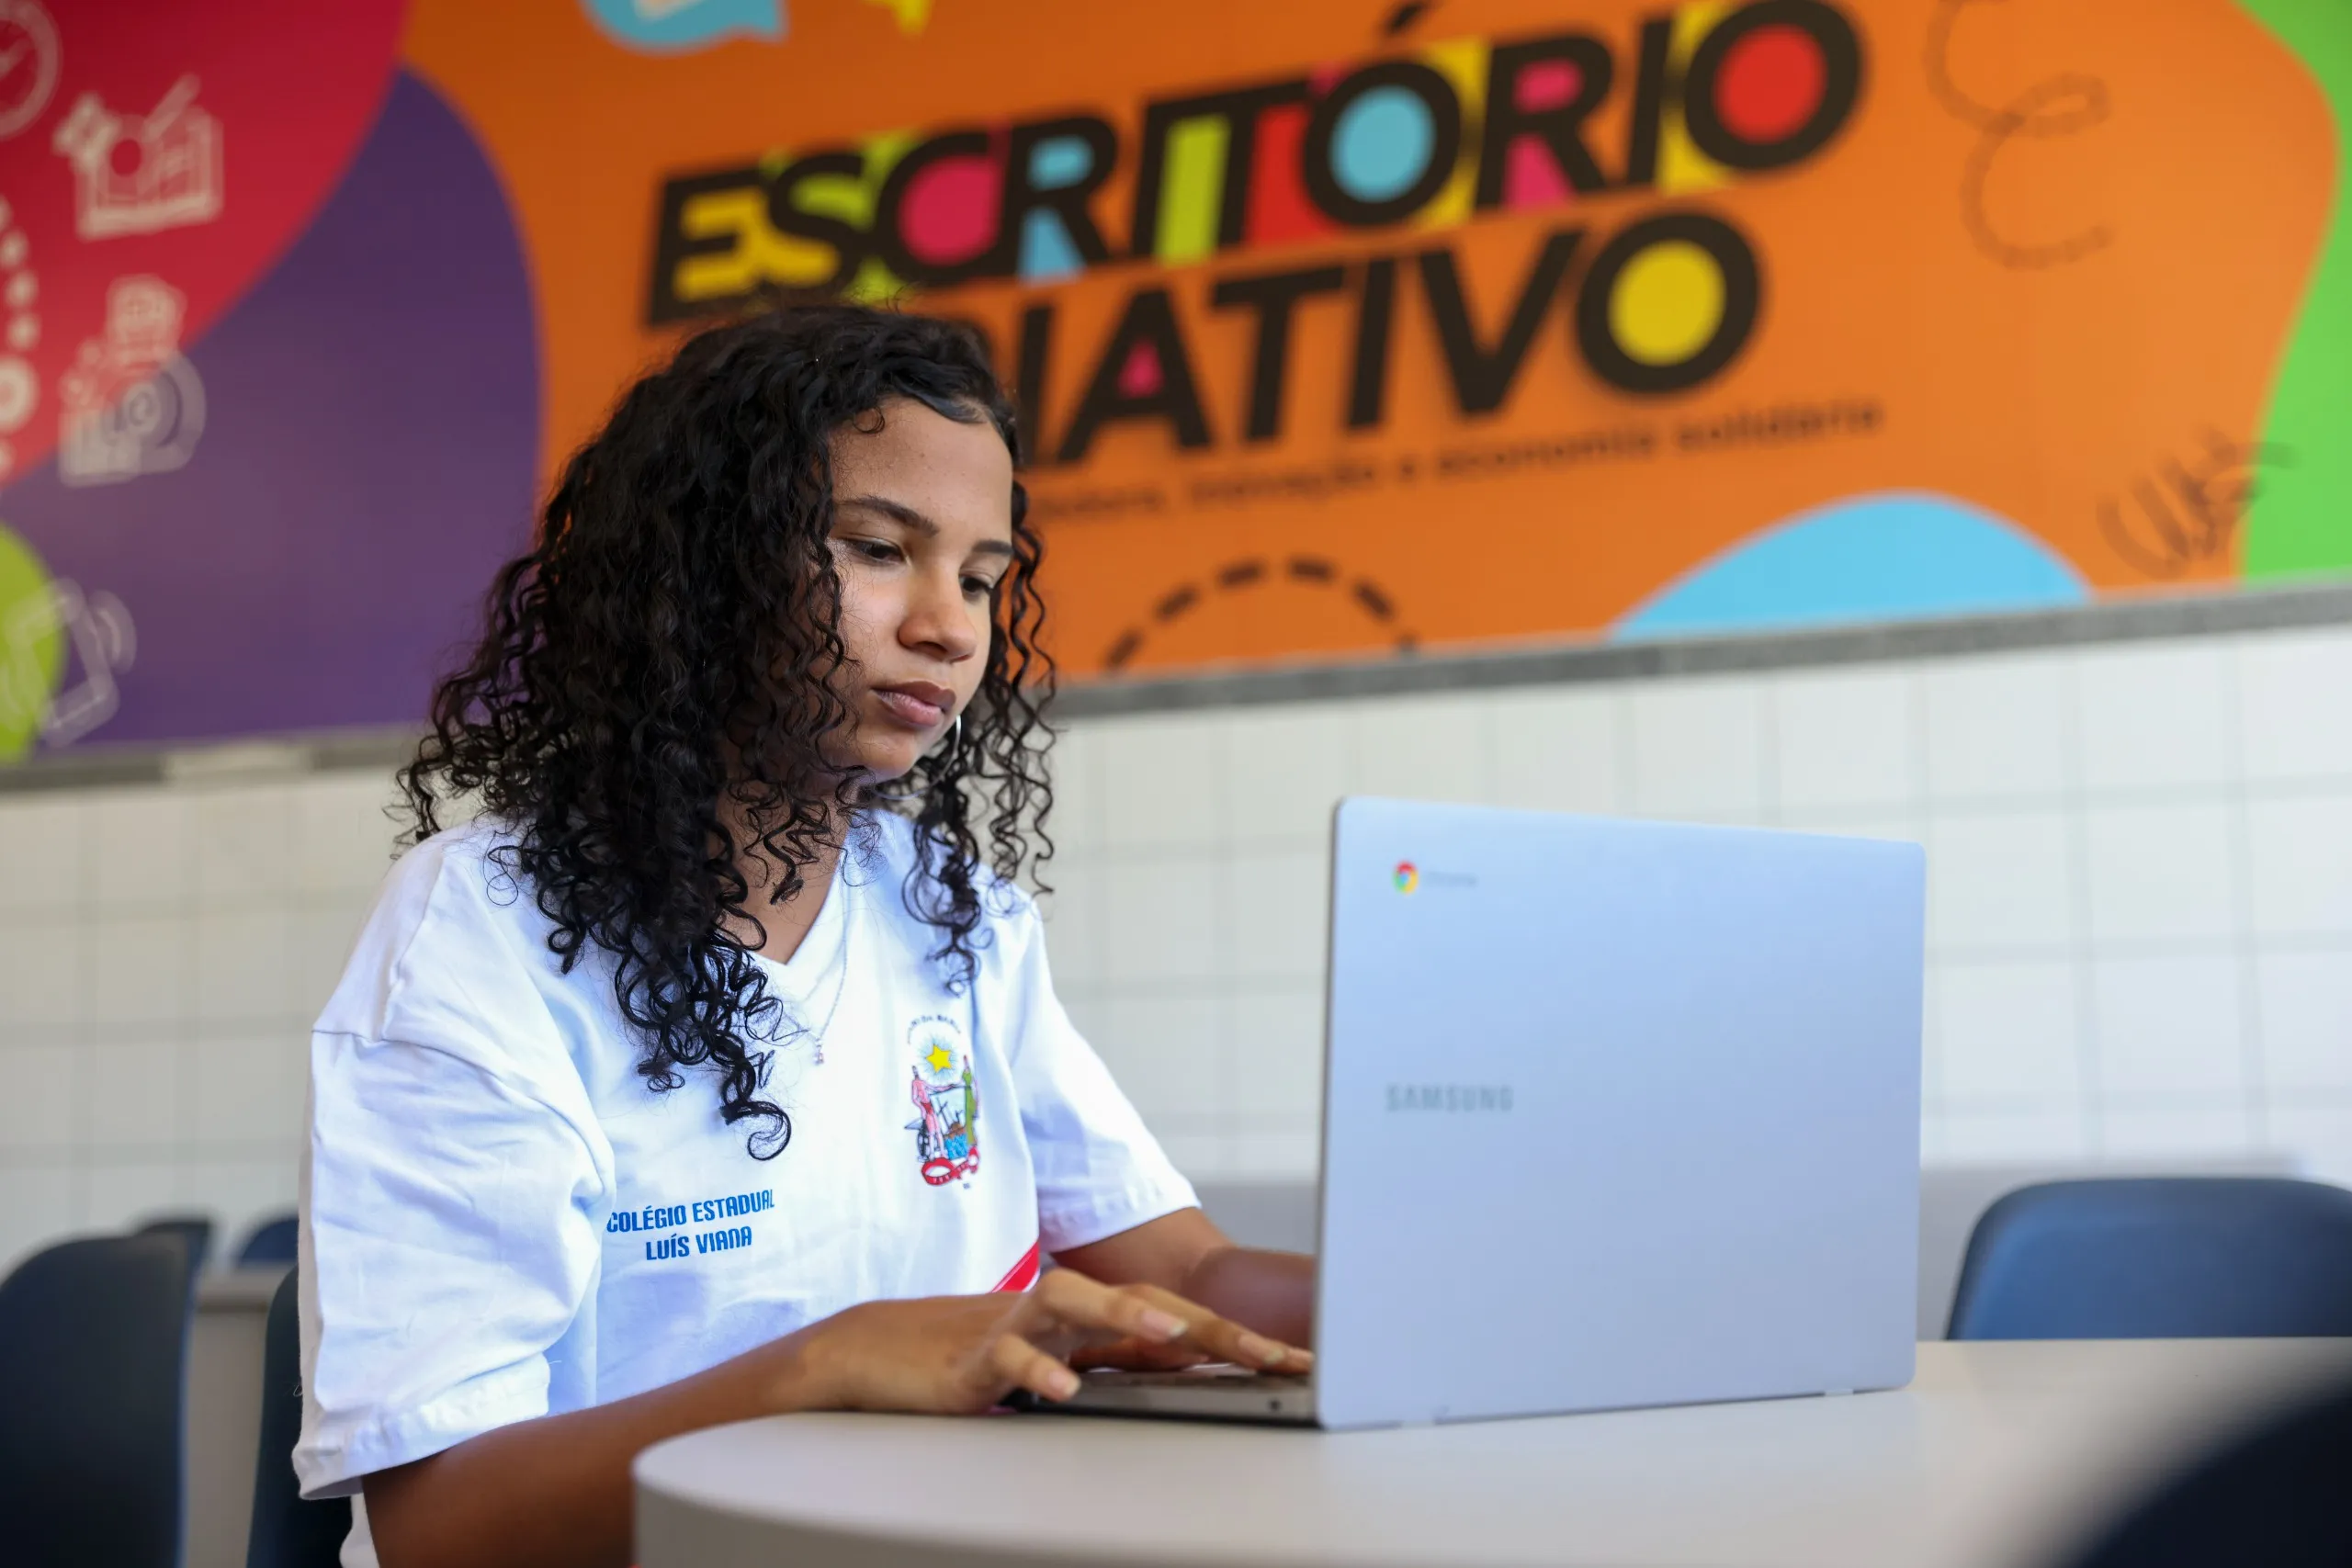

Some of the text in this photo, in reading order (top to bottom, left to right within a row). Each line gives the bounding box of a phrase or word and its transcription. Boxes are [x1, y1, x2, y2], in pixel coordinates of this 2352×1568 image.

[642, 0, 1862, 325] ESCRITÓRIO
[981, 209, 1766, 468] IATIVO
[1386, 1084, 1514, 1112] SAMSUNG
[606, 1189, 775, 1233] COLÉGIO ESTADUAL
[646, 1225, 752, 1261] LUÍS VIANA
